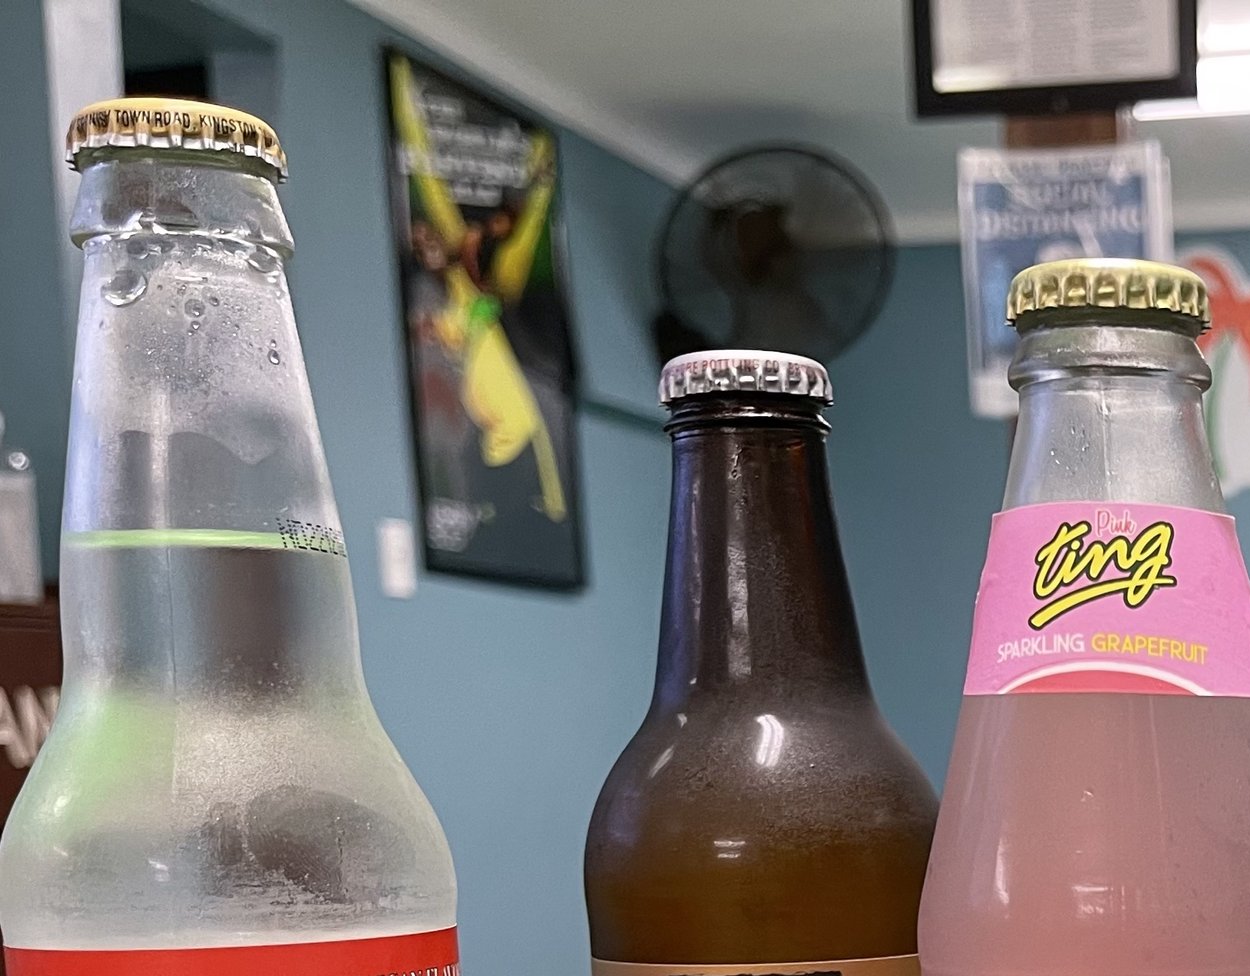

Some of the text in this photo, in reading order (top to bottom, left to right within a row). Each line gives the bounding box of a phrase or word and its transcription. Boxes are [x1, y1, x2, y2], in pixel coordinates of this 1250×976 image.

[114, 109, 150, 128] TOWN
[200, 114, 257, 139] KINGSTON
[1094, 508, 1138, 537] Pink
[1032, 520, 1177, 610] ting
[996, 631, 1208, 666] SPARKLING GRAPEFRUIT
